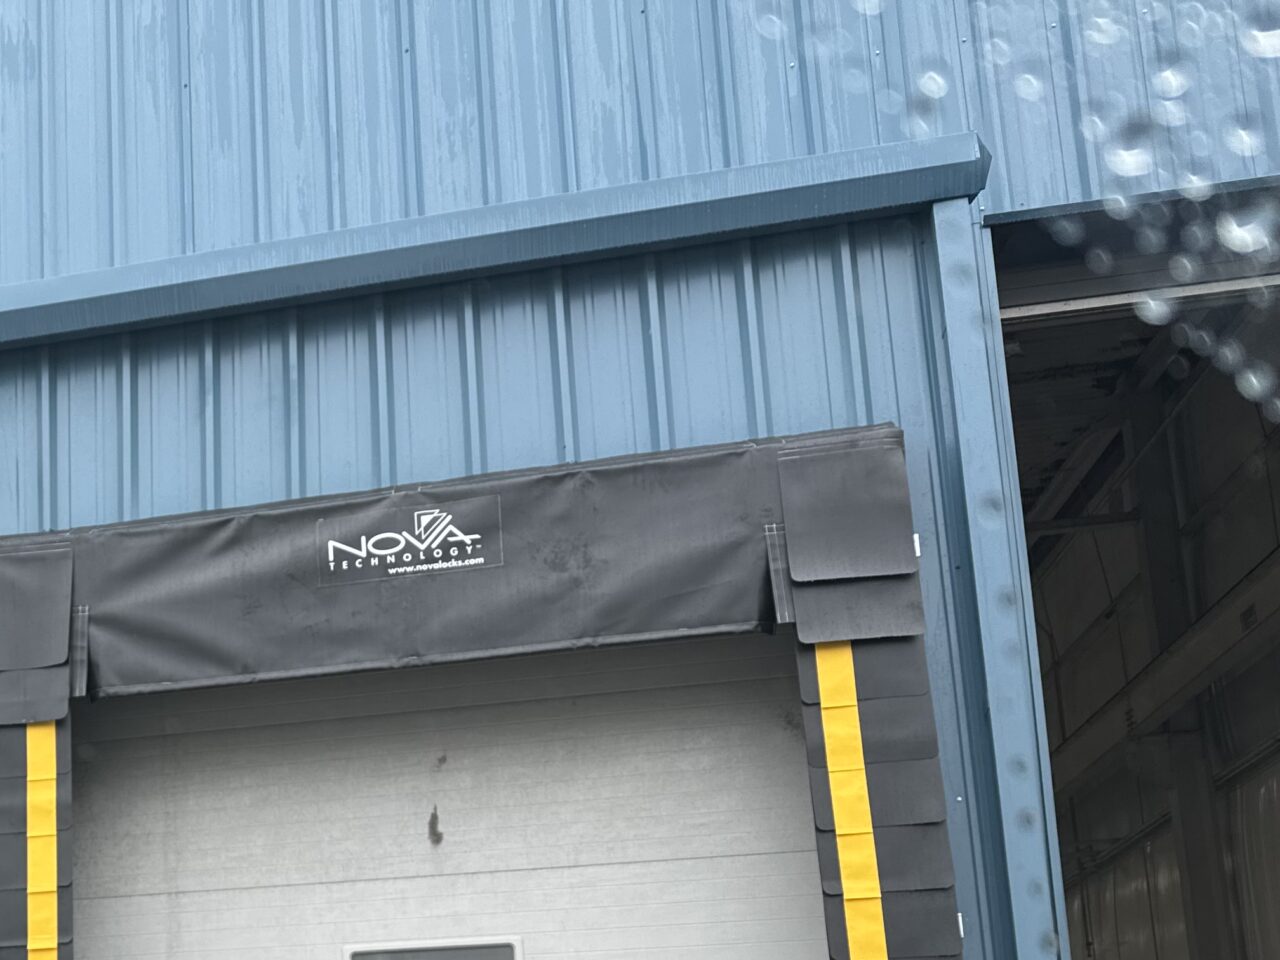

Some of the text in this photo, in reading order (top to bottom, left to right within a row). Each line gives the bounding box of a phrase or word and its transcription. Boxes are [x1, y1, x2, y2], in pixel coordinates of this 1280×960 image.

[327, 513, 482, 562] NOVA
[328, 545, 474, 572] TECHNOLOGY
[387, 556, 485, 575] www.novalocks.com
